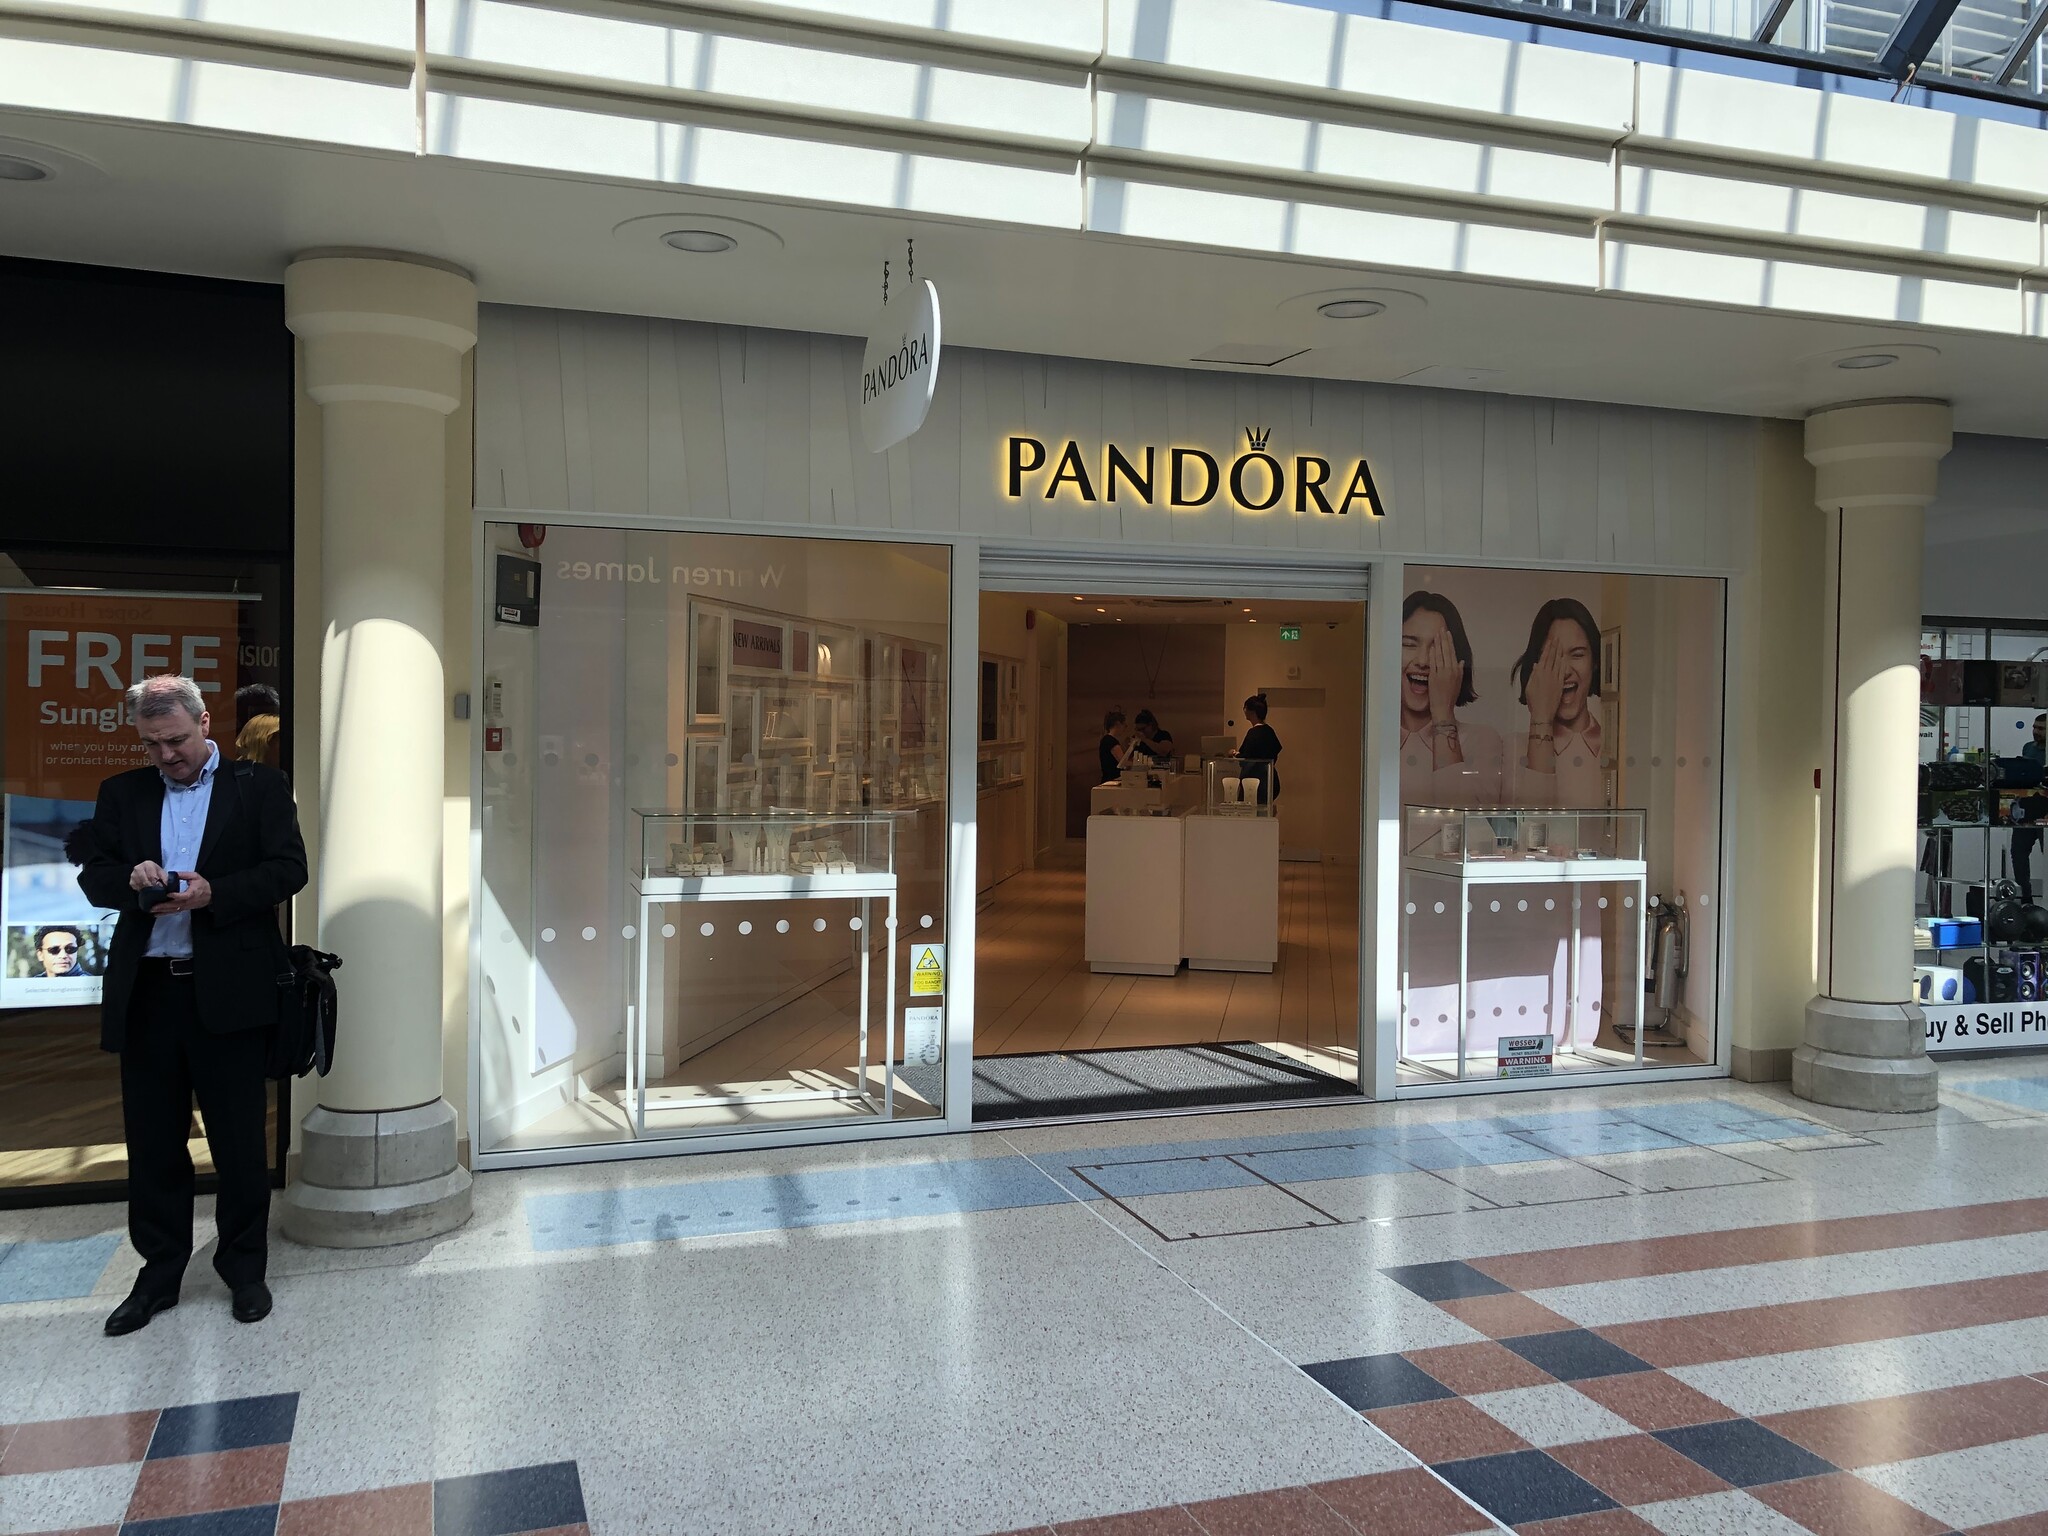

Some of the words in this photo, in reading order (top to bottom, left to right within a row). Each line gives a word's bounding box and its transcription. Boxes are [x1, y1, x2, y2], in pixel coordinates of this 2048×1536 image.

[863, 333, 928, 404] PANDORA
[1008, 436, 1386, 517] PANDORA
[733, 632, 749, 648] NEW
[751, 635, 781, 654] ARRIVALS
[28, 629, 221, 692] FREE
[45, 757, 58, 765] or
[60, 756, 101, 766] contact
[104, 756, 128, 766] lens
[129, 756, 151, 766] sub
[83, 743, 104, 753] you
[107, 742, 128, 754] buy
[1925, 1020, 1948, 1043] uy
[1954, 1014, 1969, 1036] &
[1975, 1012, 2013, 1035] Sell
[2021, 1010, 2048, 1032] Ph
[1505, 1056, 1546, 1065] WARNING
